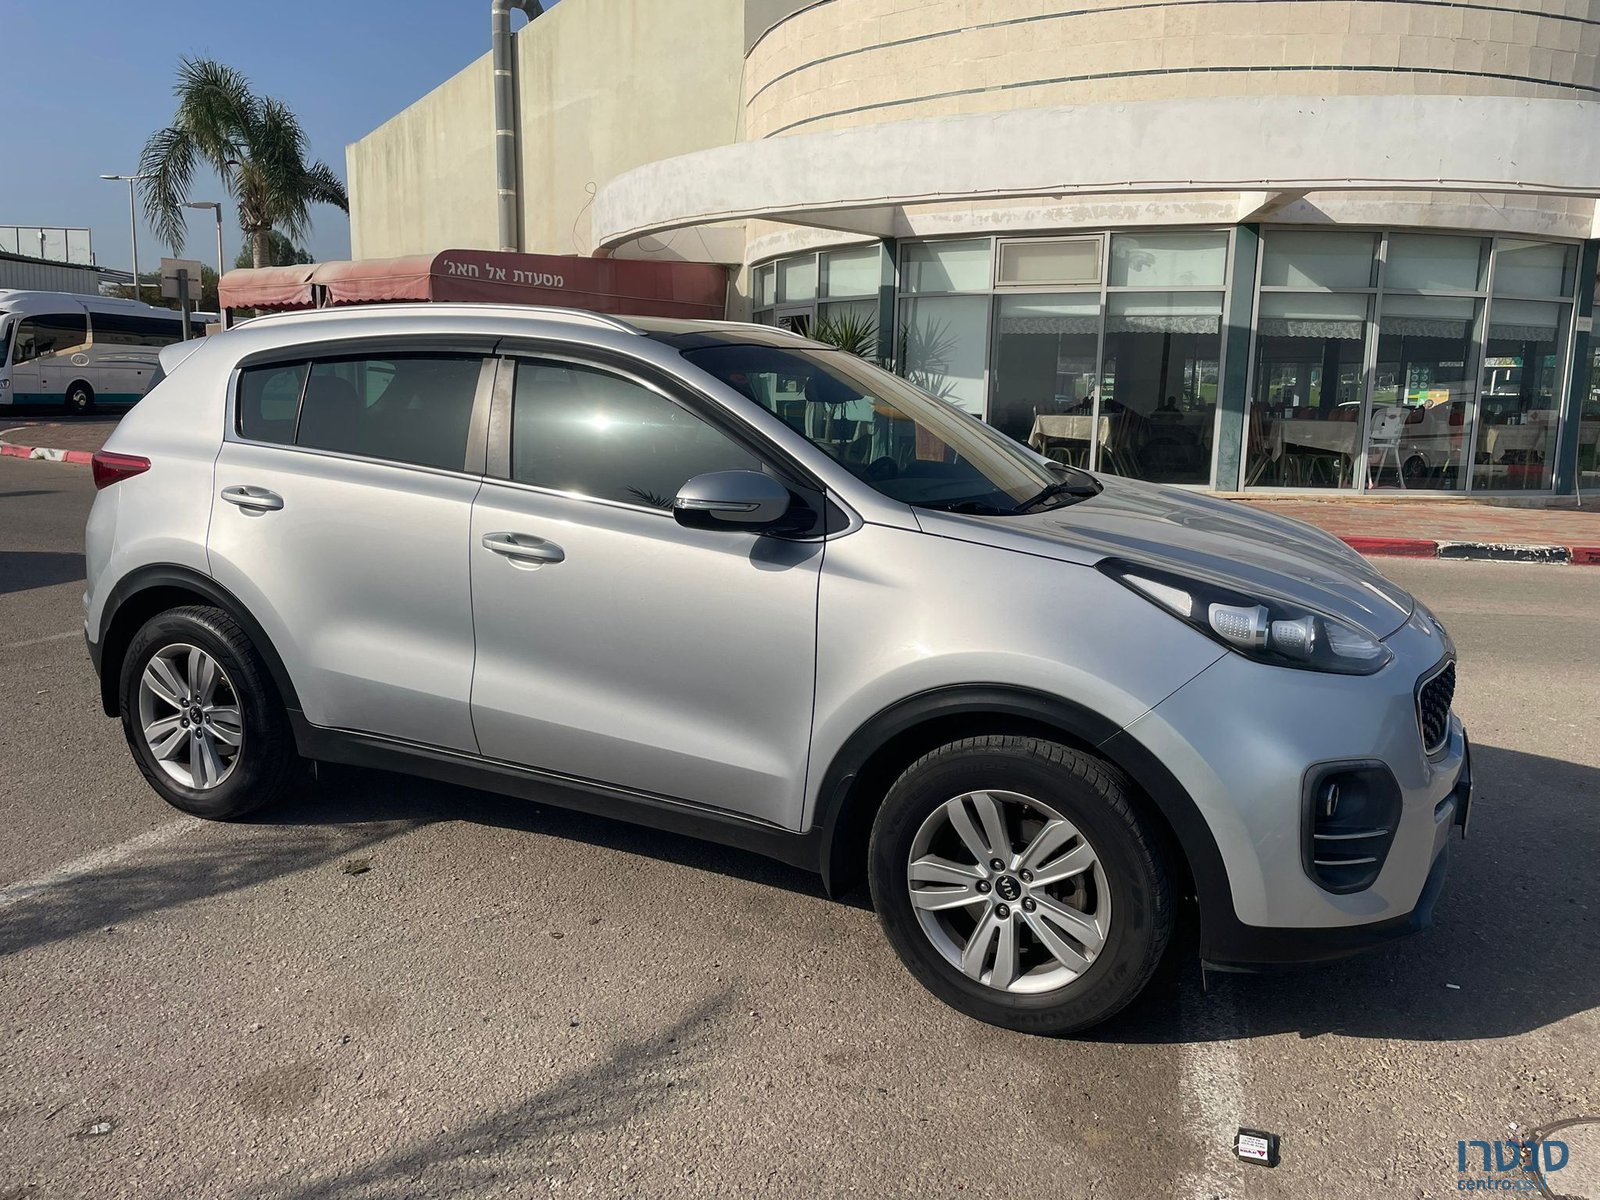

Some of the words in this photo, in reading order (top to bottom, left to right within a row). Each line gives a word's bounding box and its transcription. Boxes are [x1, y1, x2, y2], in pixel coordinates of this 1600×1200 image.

[485, 263, 506, 280] אל
[513, 269, 564, 287] מסעדת
[1001, 876, 1016, 899] KIA
